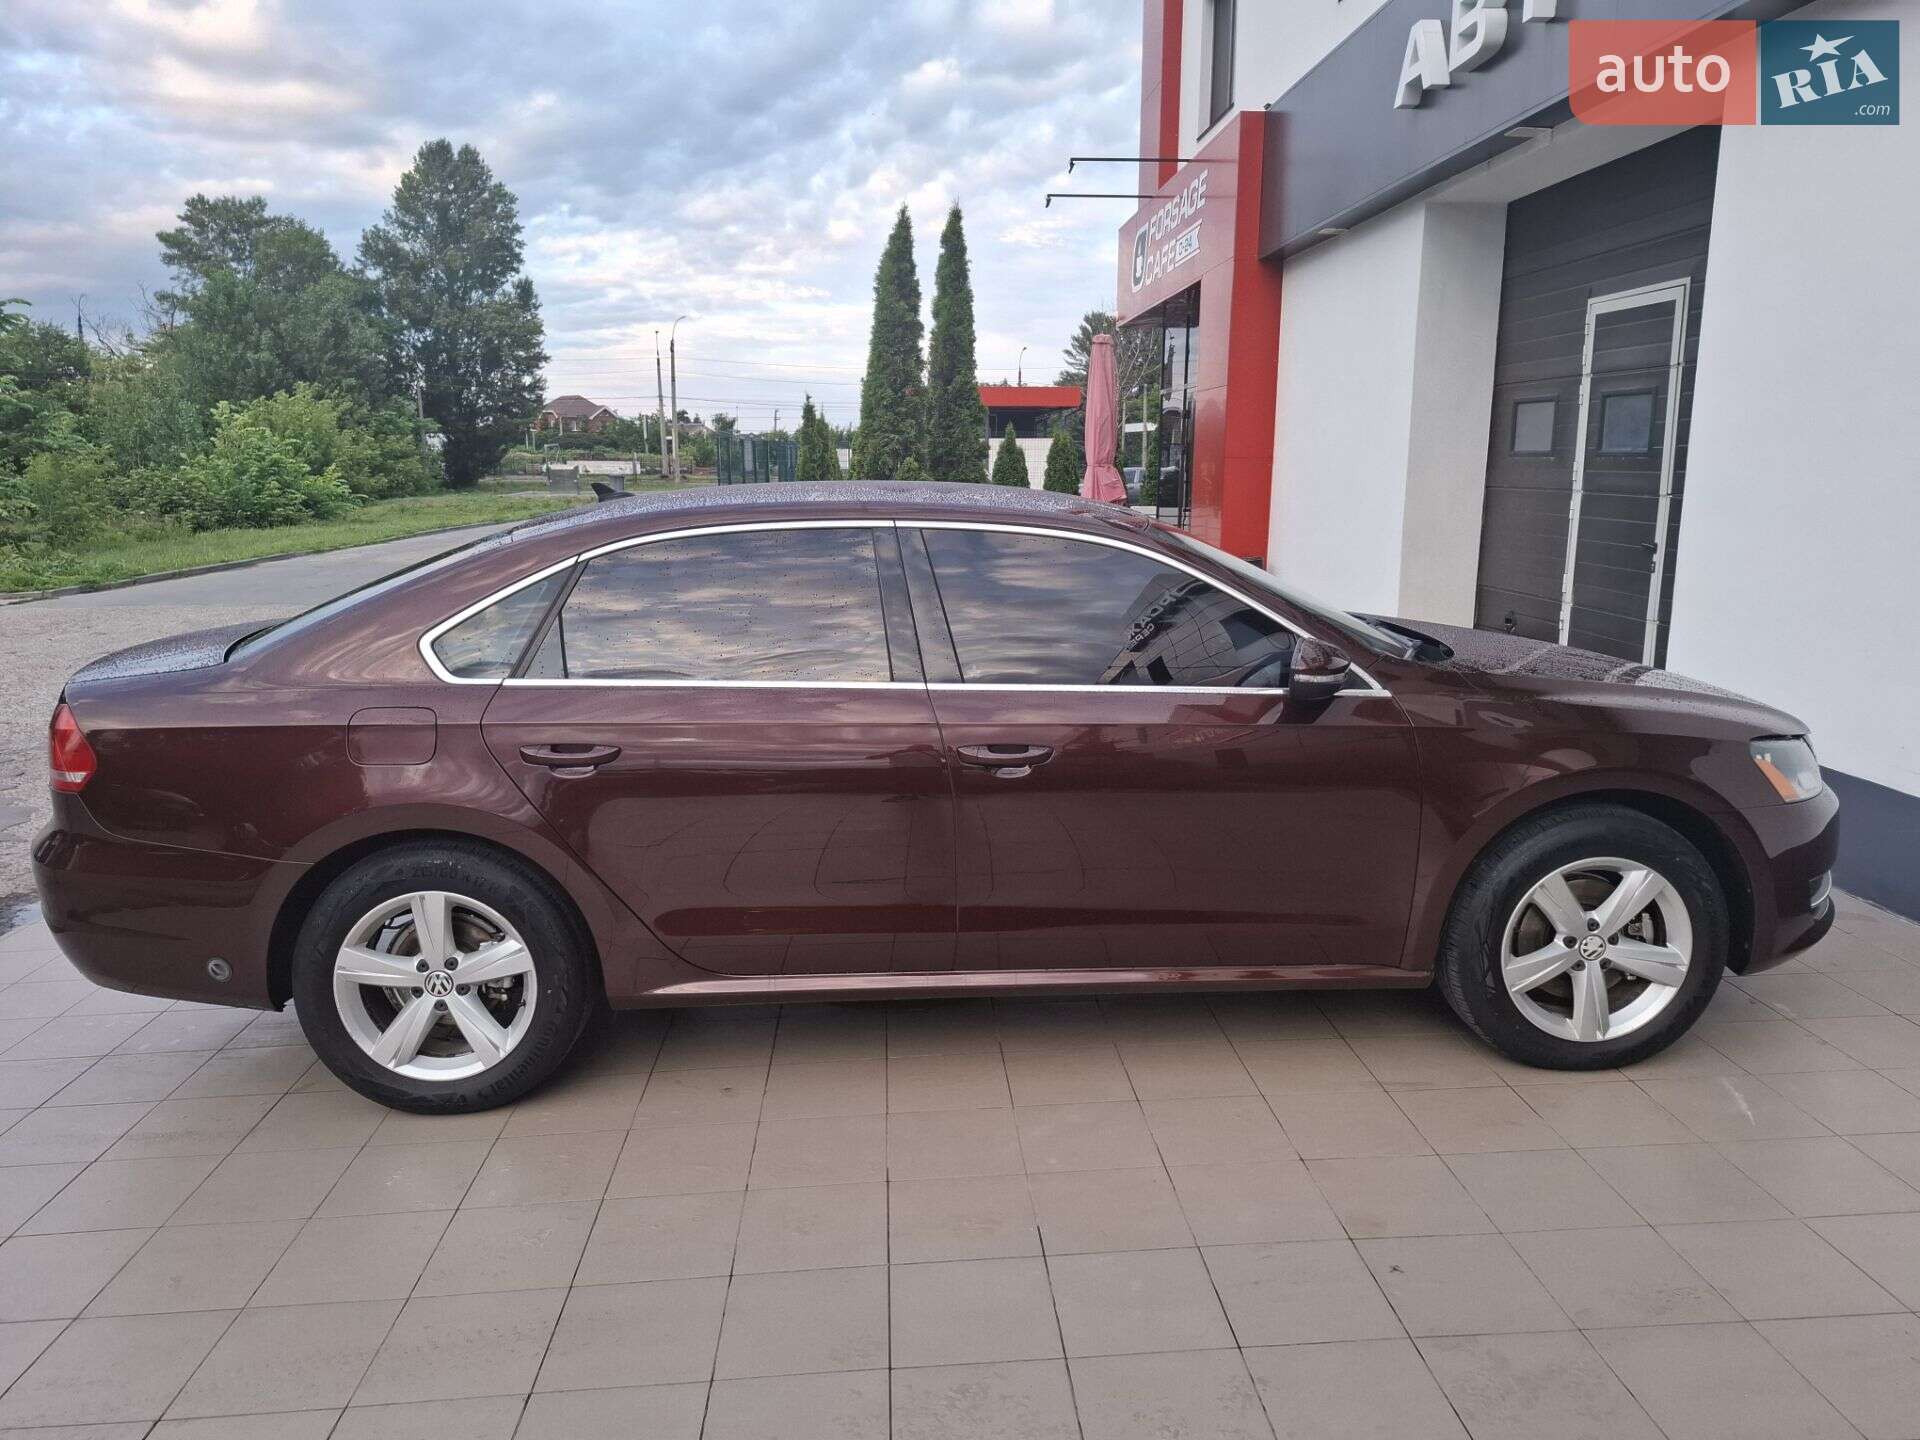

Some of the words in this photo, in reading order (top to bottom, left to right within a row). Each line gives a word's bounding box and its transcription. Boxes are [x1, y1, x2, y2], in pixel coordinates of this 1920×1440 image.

[1393, 0, 1557, 109] АВ
[1148, 168, 1209, 246] FORSAGE
[1144, 237, 1177, 286] CAFE
